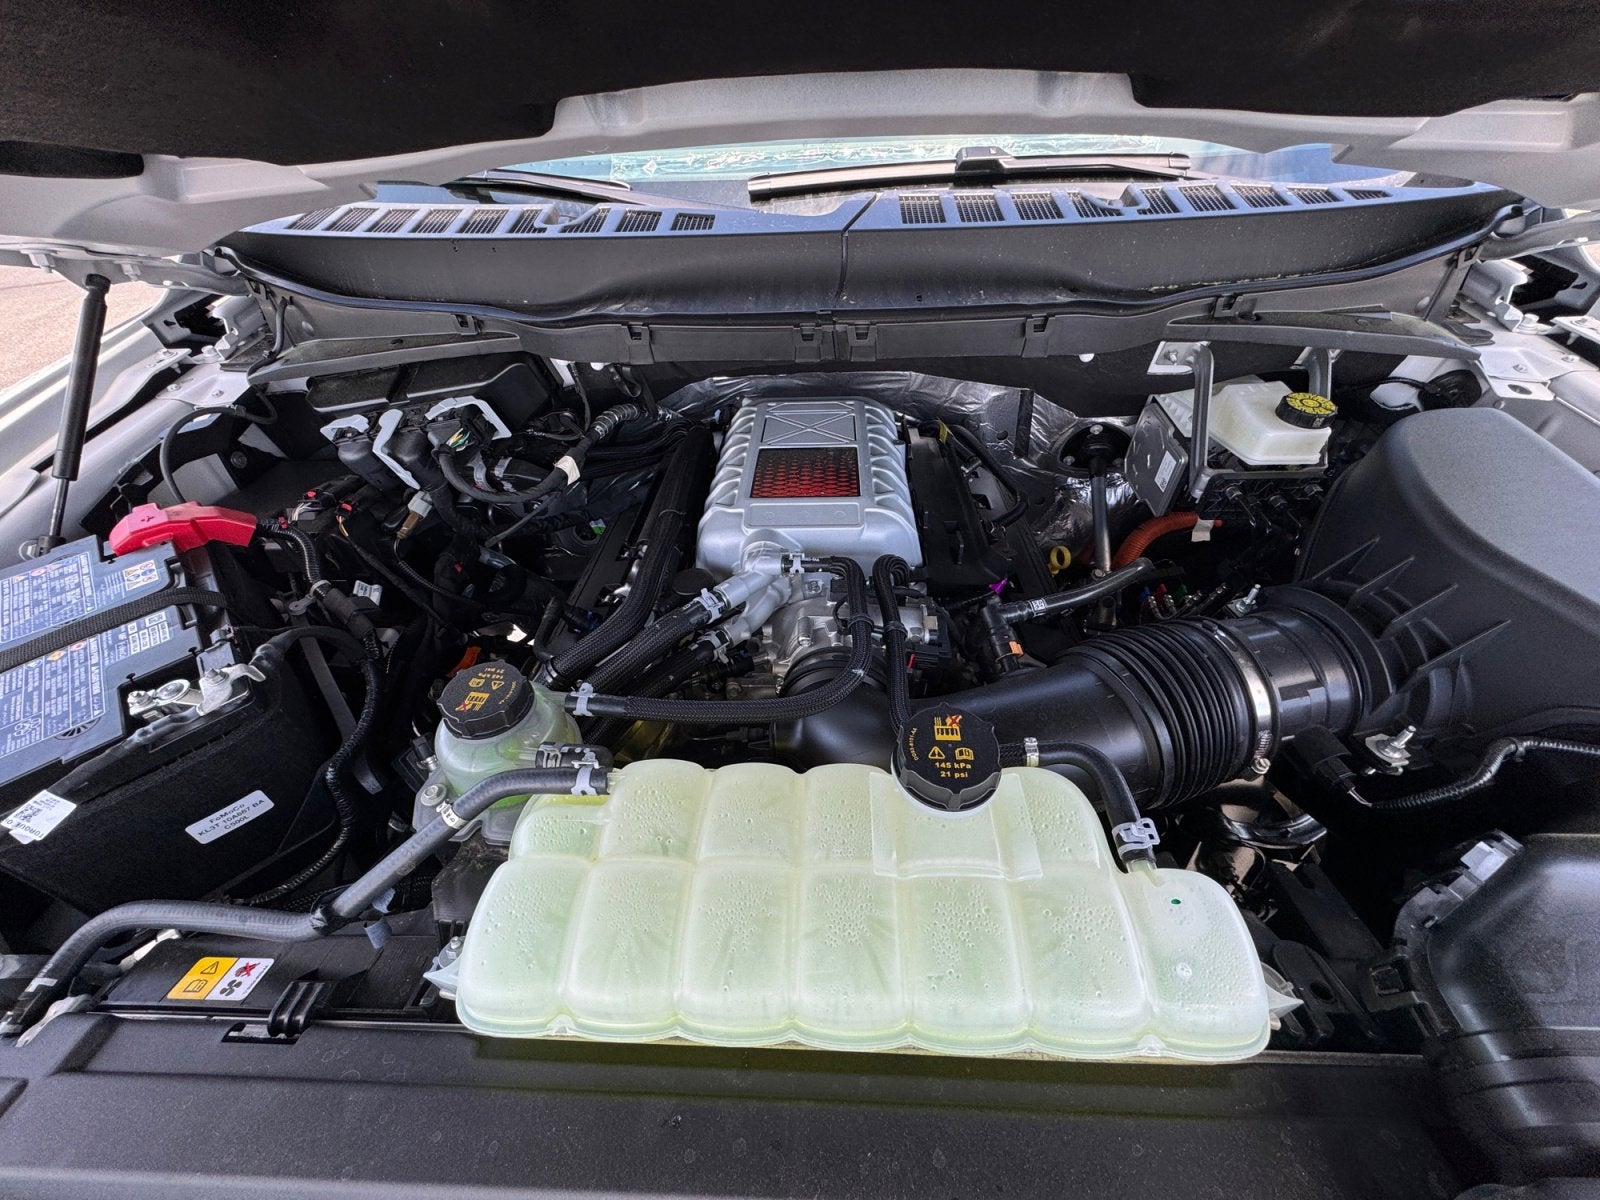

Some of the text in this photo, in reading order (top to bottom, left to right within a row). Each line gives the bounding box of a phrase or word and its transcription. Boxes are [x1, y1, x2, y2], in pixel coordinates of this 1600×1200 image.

[954, 771, 968, 779] psi
[209, 803, 246, 824] FoMoCo
[198, 823, 221, 836] KL3T
